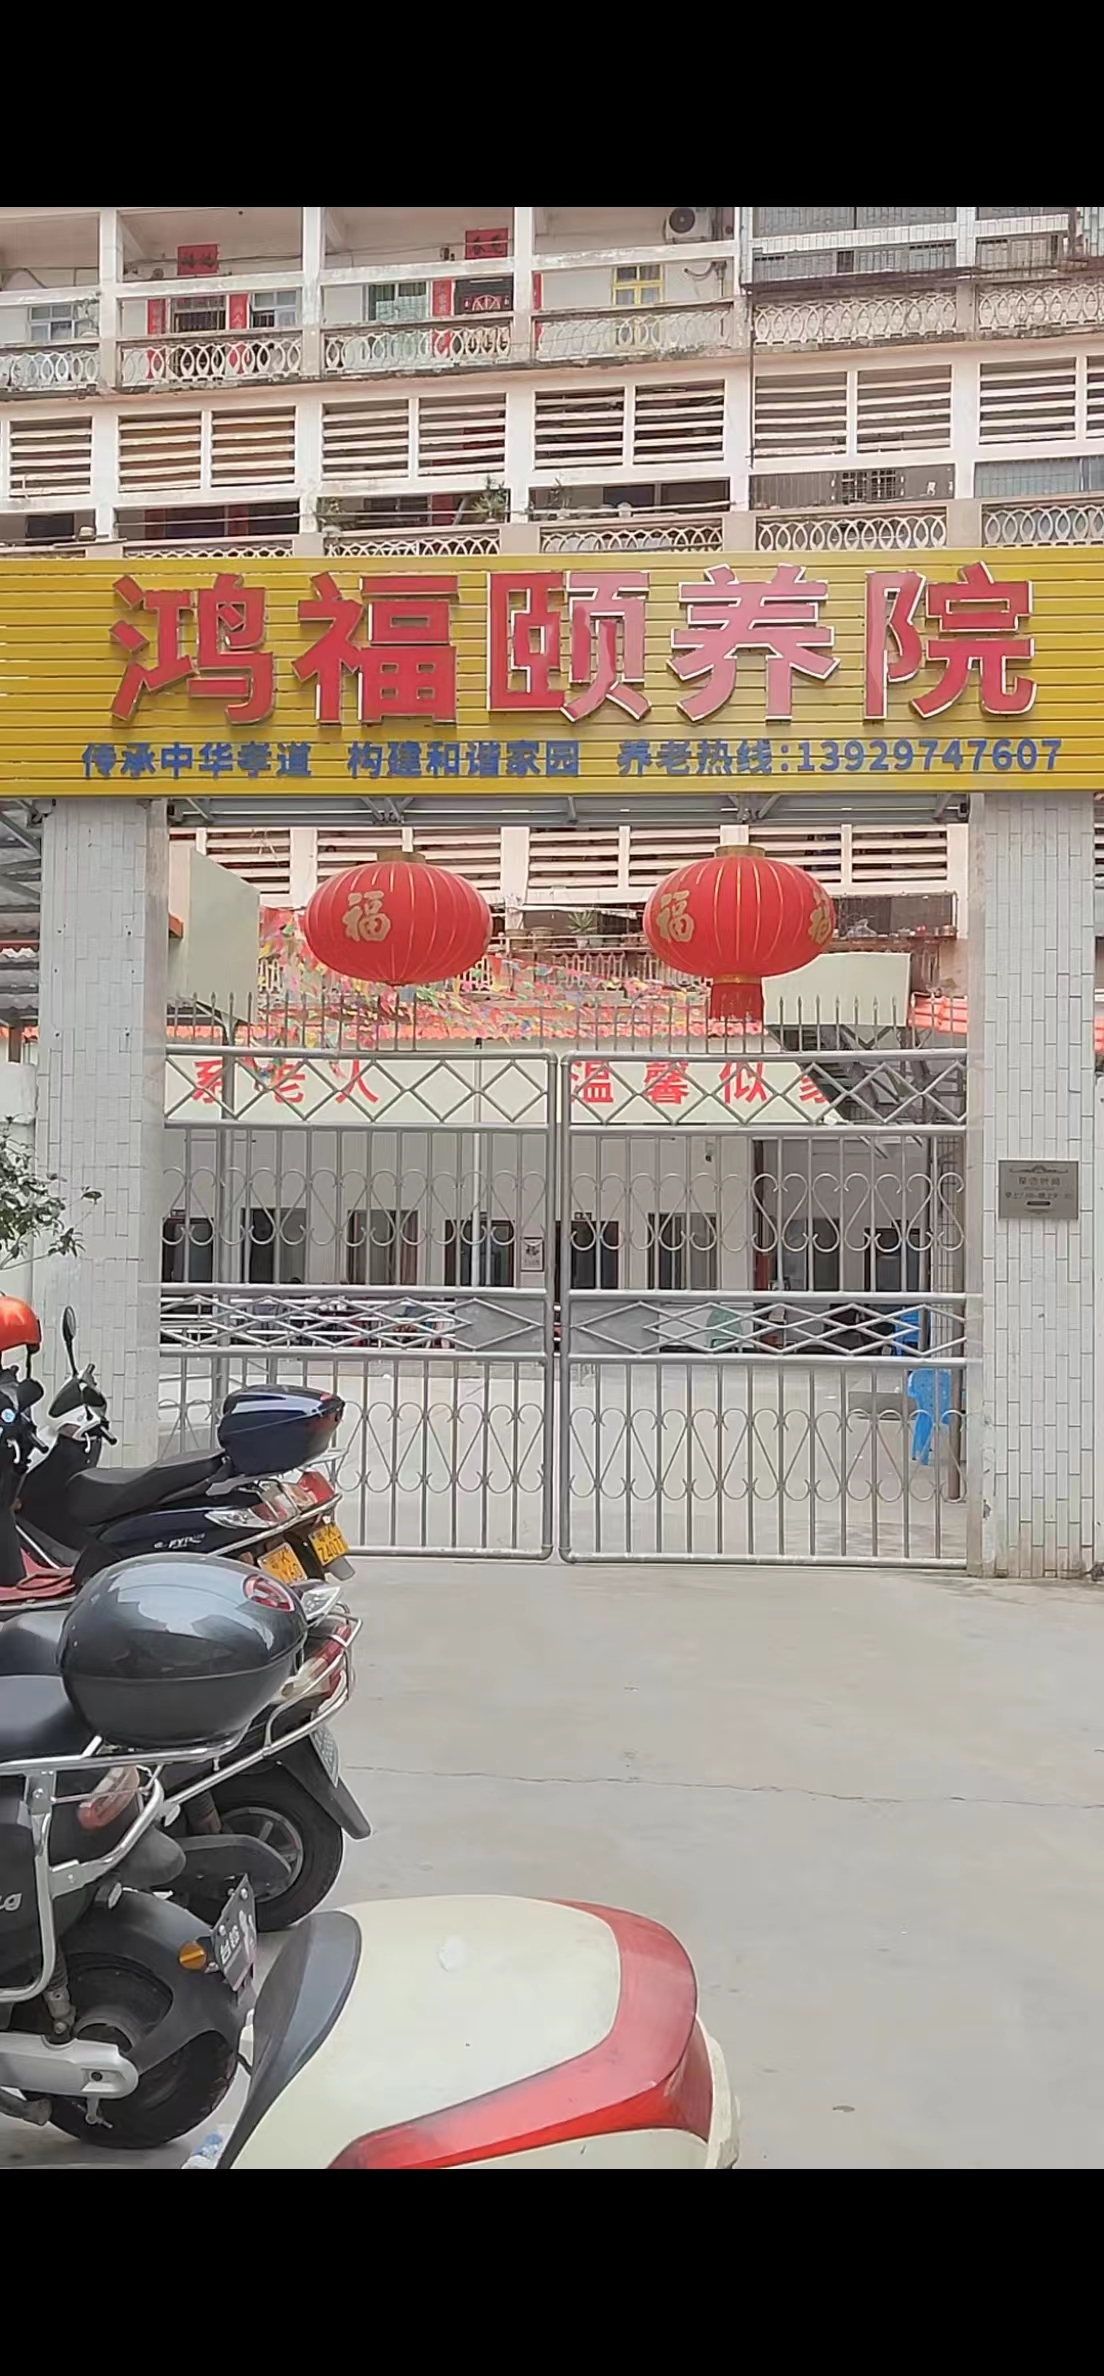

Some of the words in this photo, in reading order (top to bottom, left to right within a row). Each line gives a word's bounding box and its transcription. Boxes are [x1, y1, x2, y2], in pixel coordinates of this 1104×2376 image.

[109, 561, 1037, 726] 鸿福颐养院
[81, 740, 312, 778] 传承中华孝道
[348, 739, 580, 778] 构建和谐家园
[343, 889, 391, 942] 福
[656, 889, 694, 943] 福
